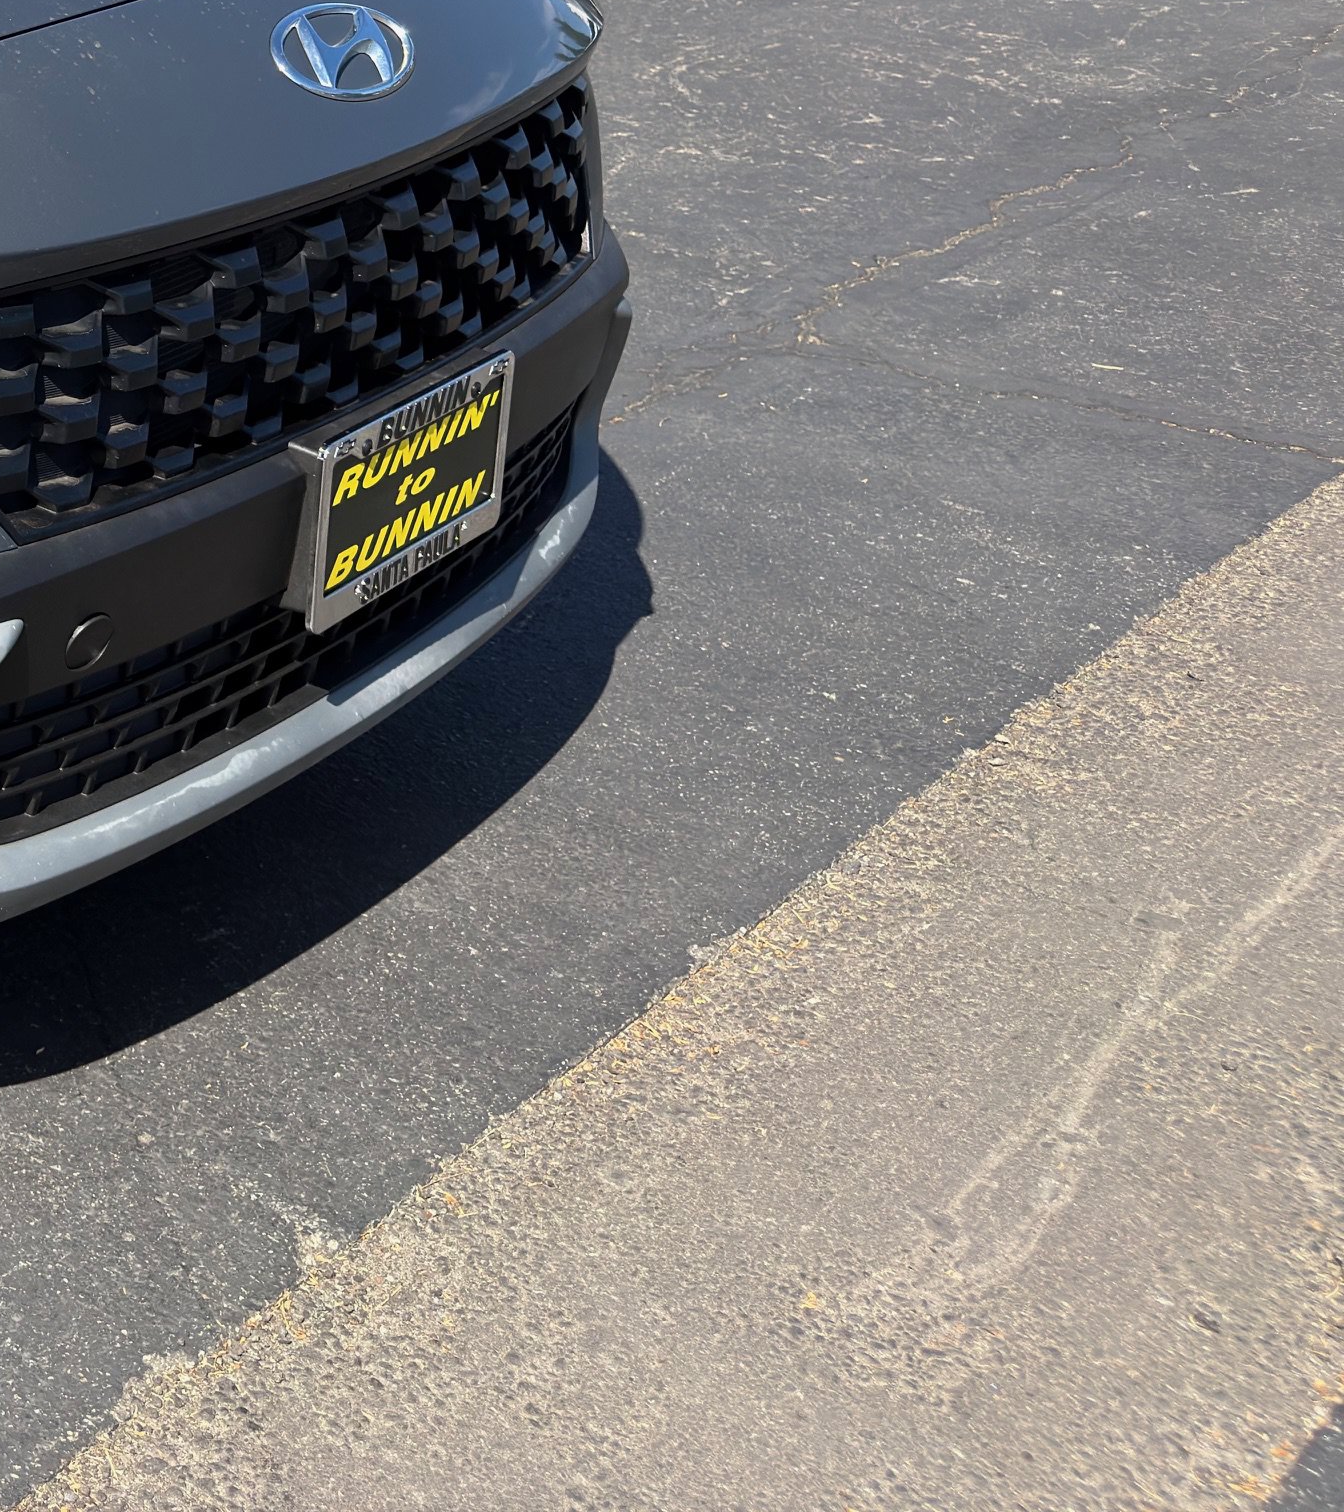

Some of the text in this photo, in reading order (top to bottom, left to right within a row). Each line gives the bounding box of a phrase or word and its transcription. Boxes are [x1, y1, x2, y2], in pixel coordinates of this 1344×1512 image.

[378, 375, 472, 449] BUNNIN
[394, 466, 436, 506] to
[324, 469, 486, 591] BUNNIN
[353, 519, 469, 605] SANTA PAULA
